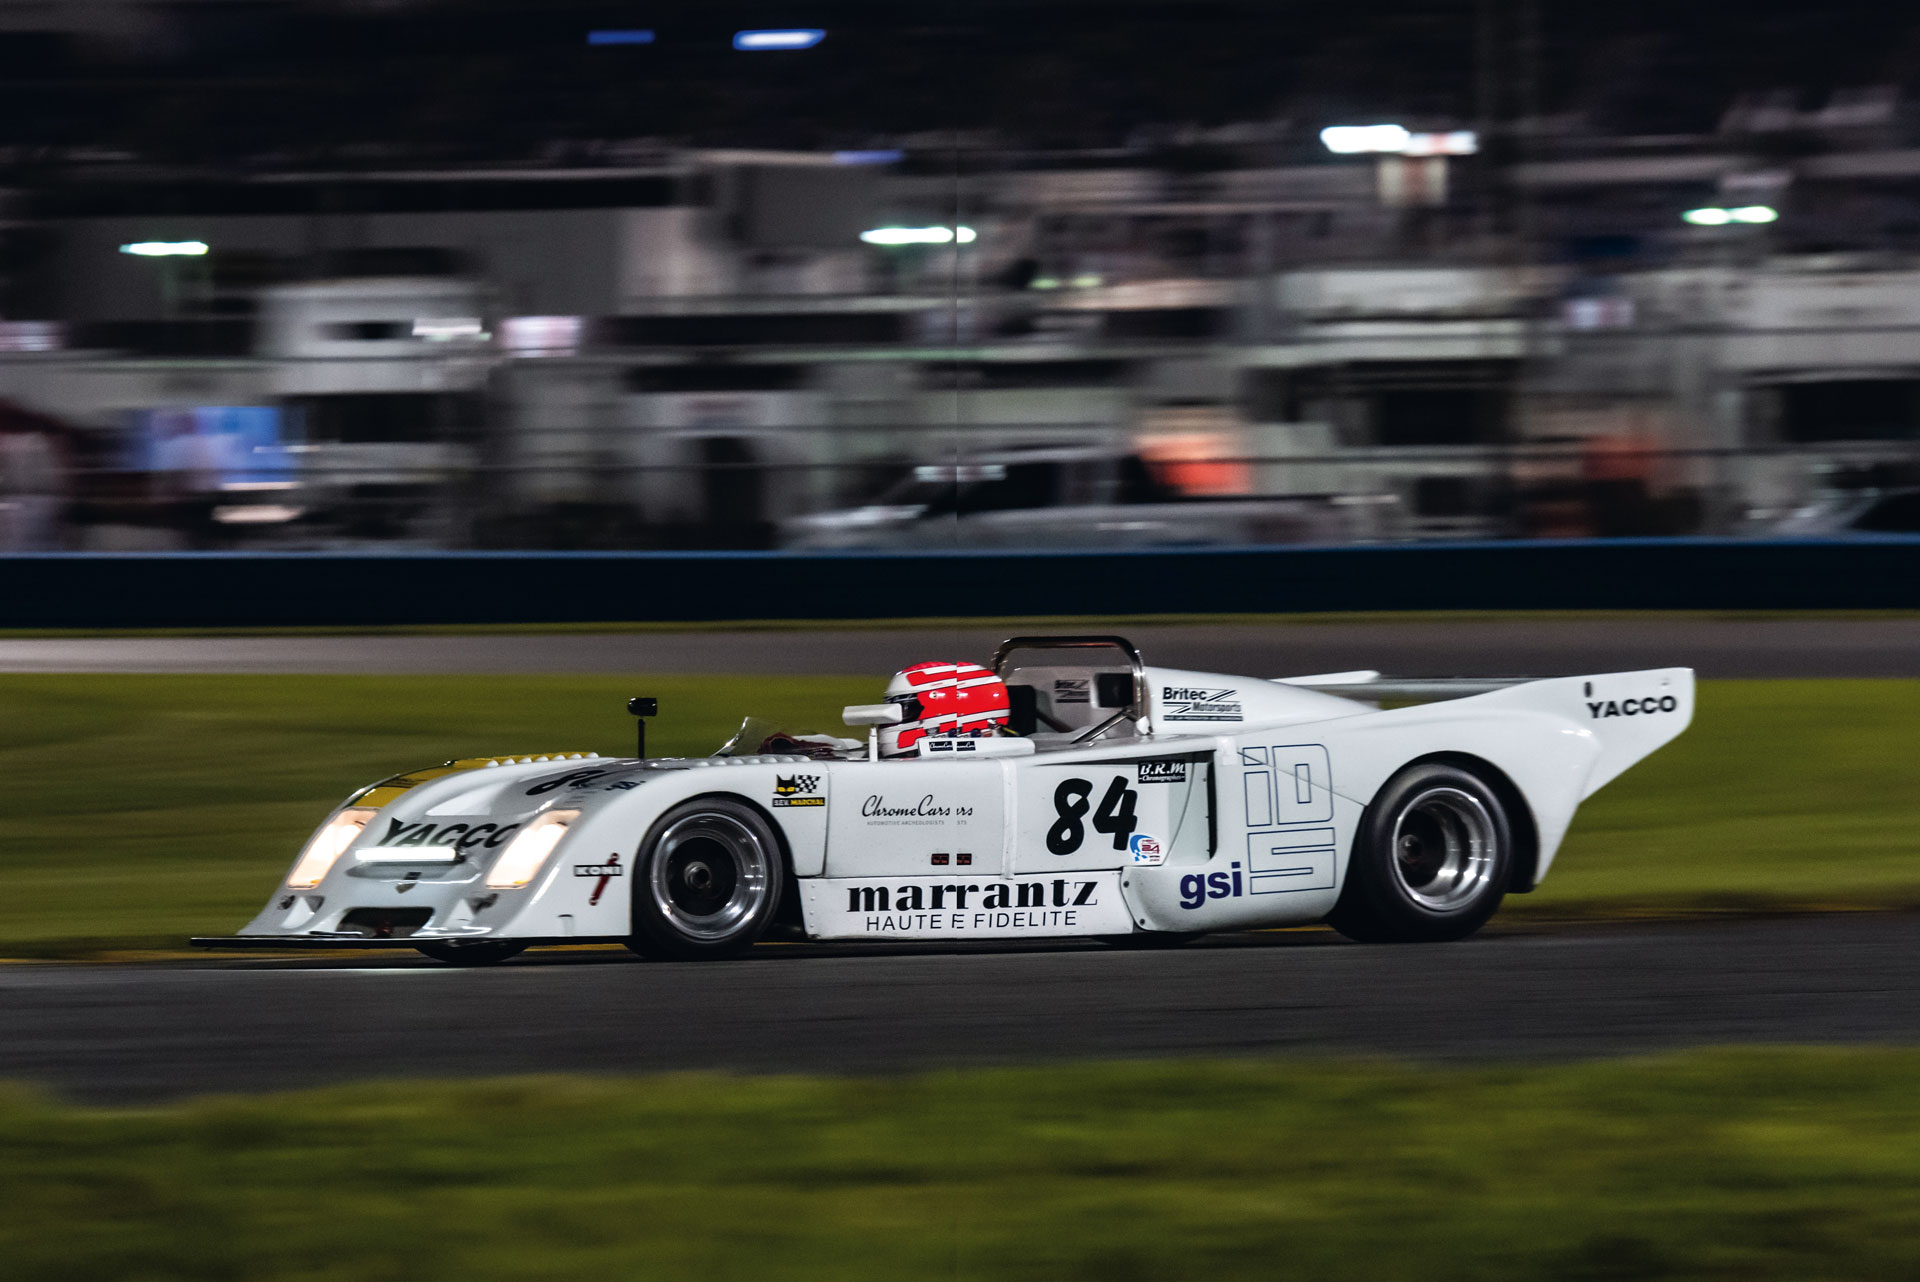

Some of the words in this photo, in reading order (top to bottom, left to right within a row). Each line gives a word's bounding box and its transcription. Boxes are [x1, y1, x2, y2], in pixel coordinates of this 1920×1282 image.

[1162, 687, 1208, 701] Britec
[1586, 695, 1677, 718] YACCO
[1140, 762, 1185, 775] B.R.M
[862, 794, 951, 818] ChromeCars
[1046, 775, 1138, 856] 84
[576, 865, 622, 876] KONI
[846, 878, 1099, 913] marrantz
[1179, 861, 1243, 910] gsi
[866, 914, 942, 931] HAUTE
[974, 910, 1078, 928] FIDELITE
